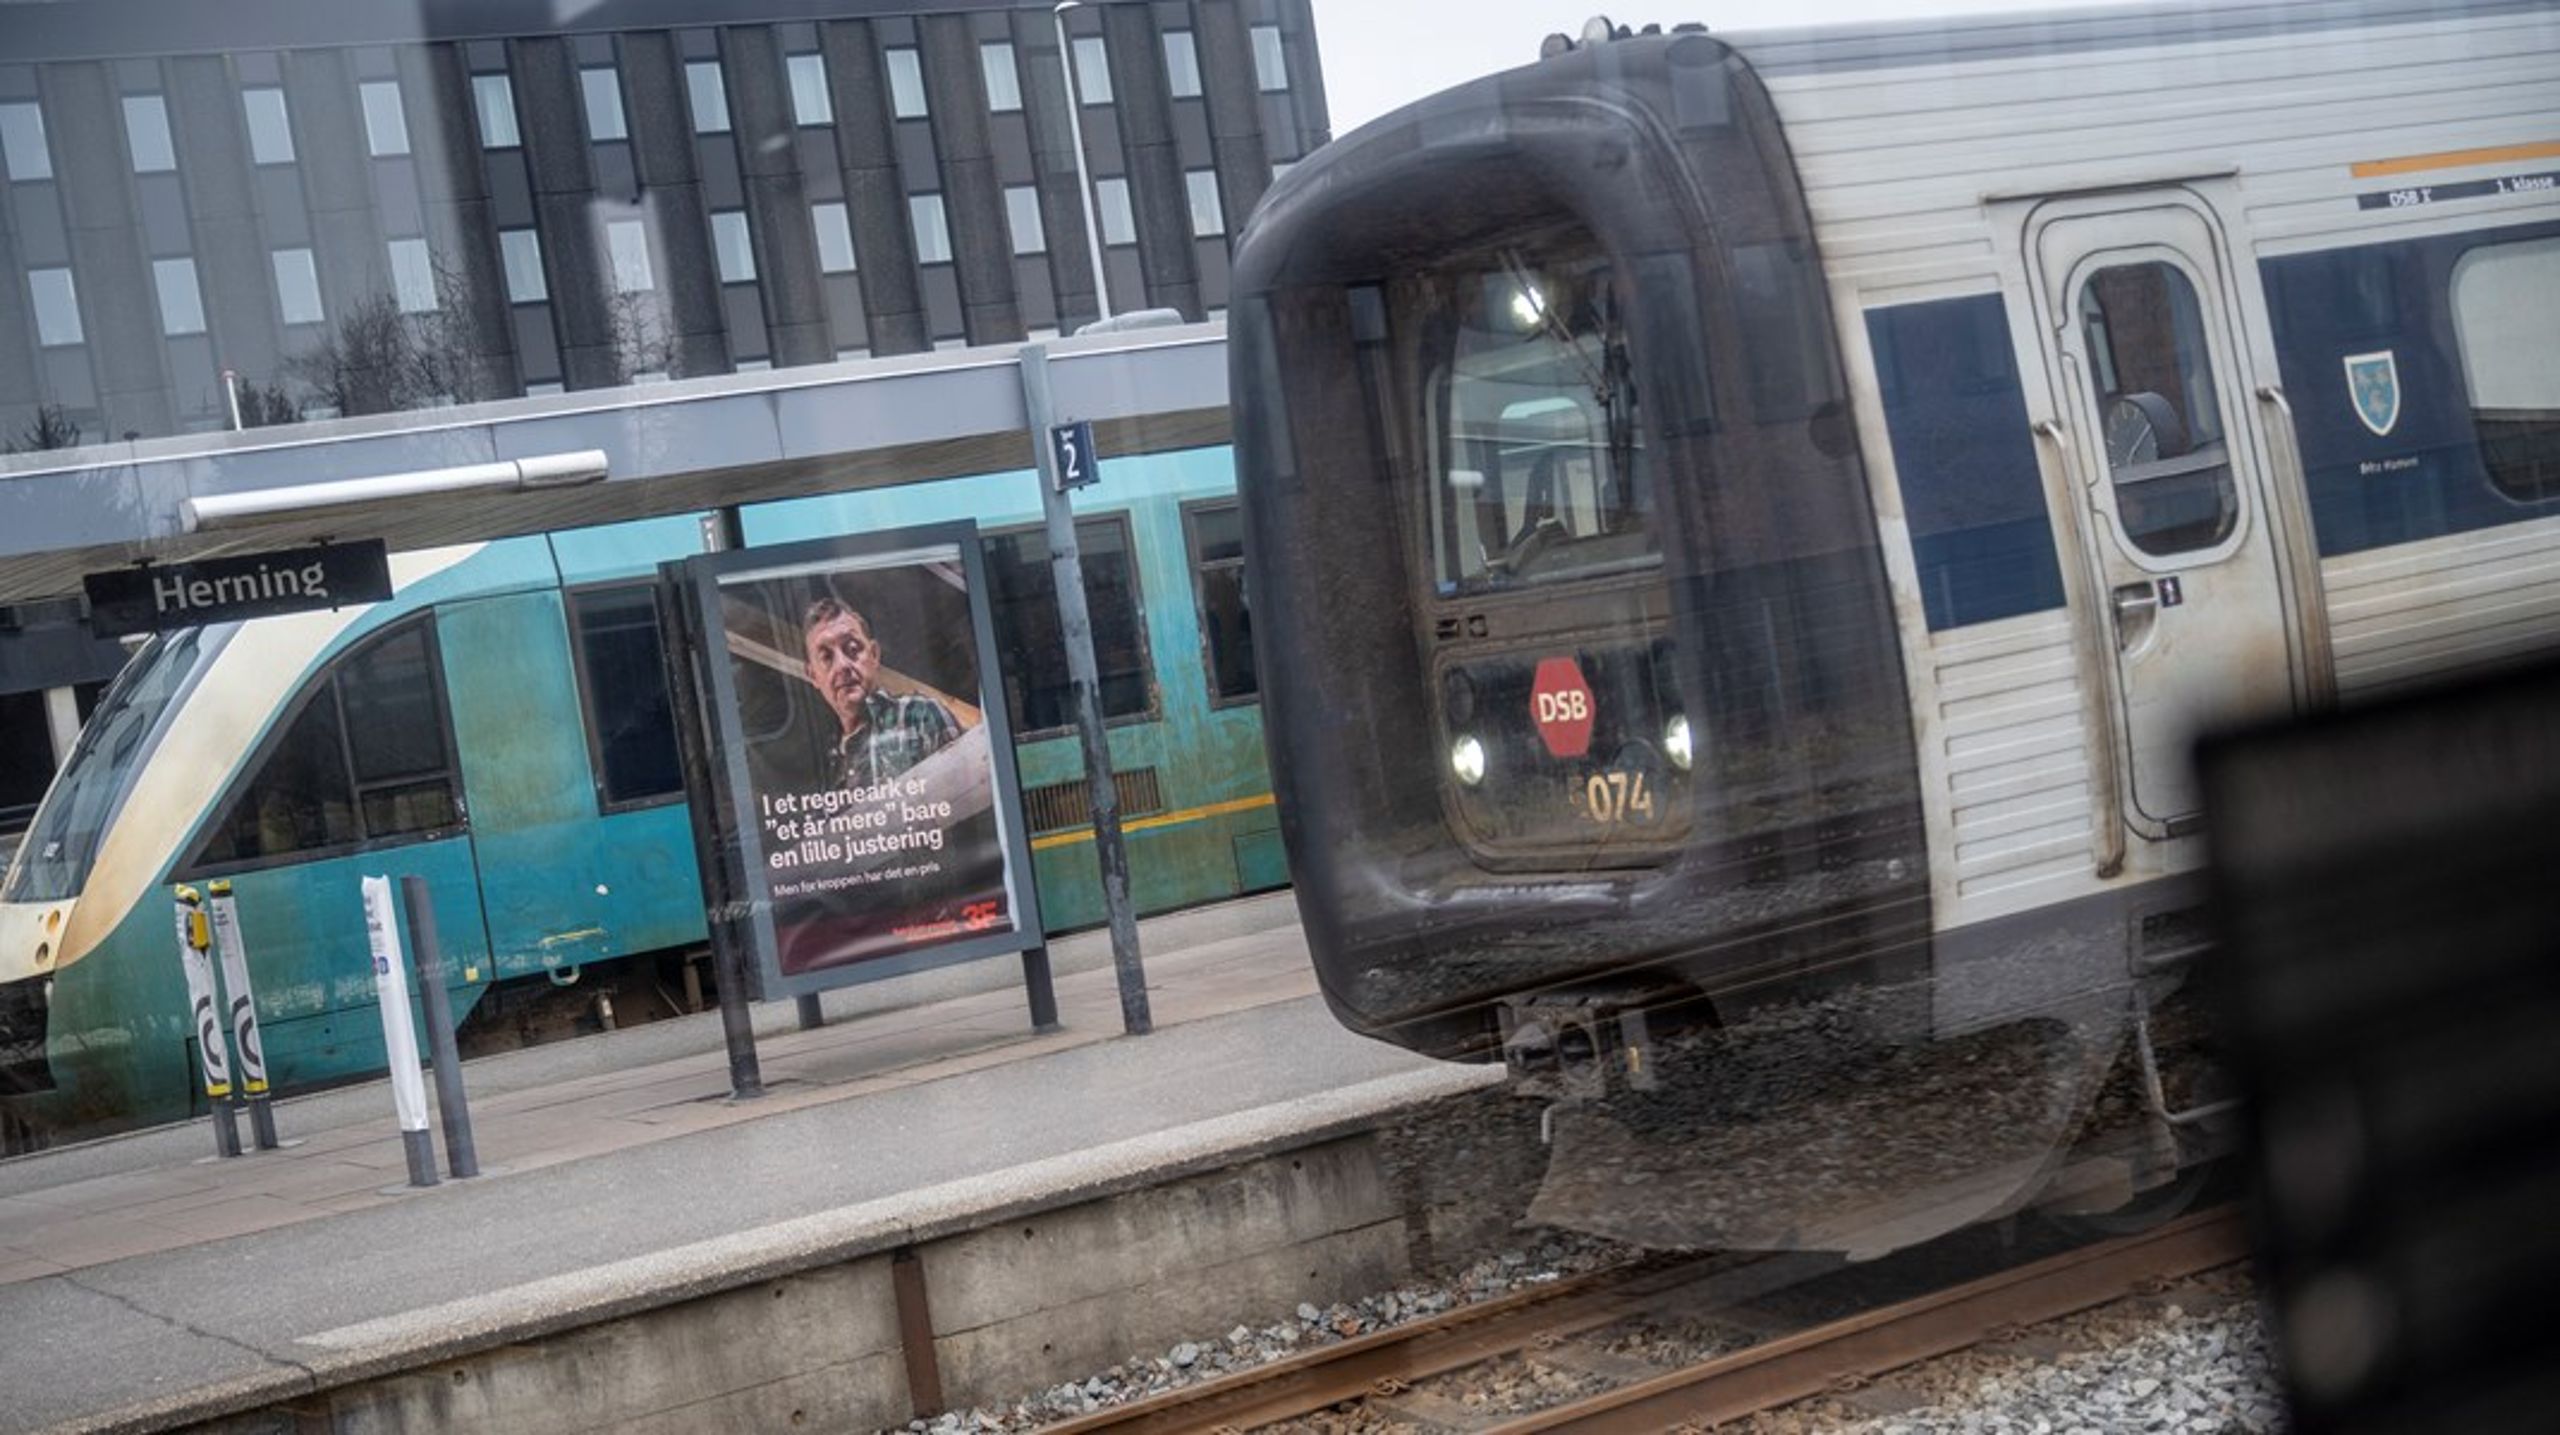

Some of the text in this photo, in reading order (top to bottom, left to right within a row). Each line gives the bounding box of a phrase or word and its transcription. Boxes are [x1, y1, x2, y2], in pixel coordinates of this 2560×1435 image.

[2512, 176, 2555, 192] klasse
[1063, 443, 1080, 478] 2
[153, 562, 328, 612] Herning
[1537, 690, 1588, 723] DSB
[762, 777, 927, 816] I et regneark er
[803, 815, 827, 838] år
[902, 801, 951, 823] bare
[770, 827, 943, 869] en lille justering
[774, 881, 799, 897] Men
[817, 873, 863, 891] kroppen
[863, 871, 884, 885] har
[884, 867, 902, 881] det
[903, 868, 918, 877] en
[917, 861, 941, 878] pris
[962, 901, 996, 931] 3F
